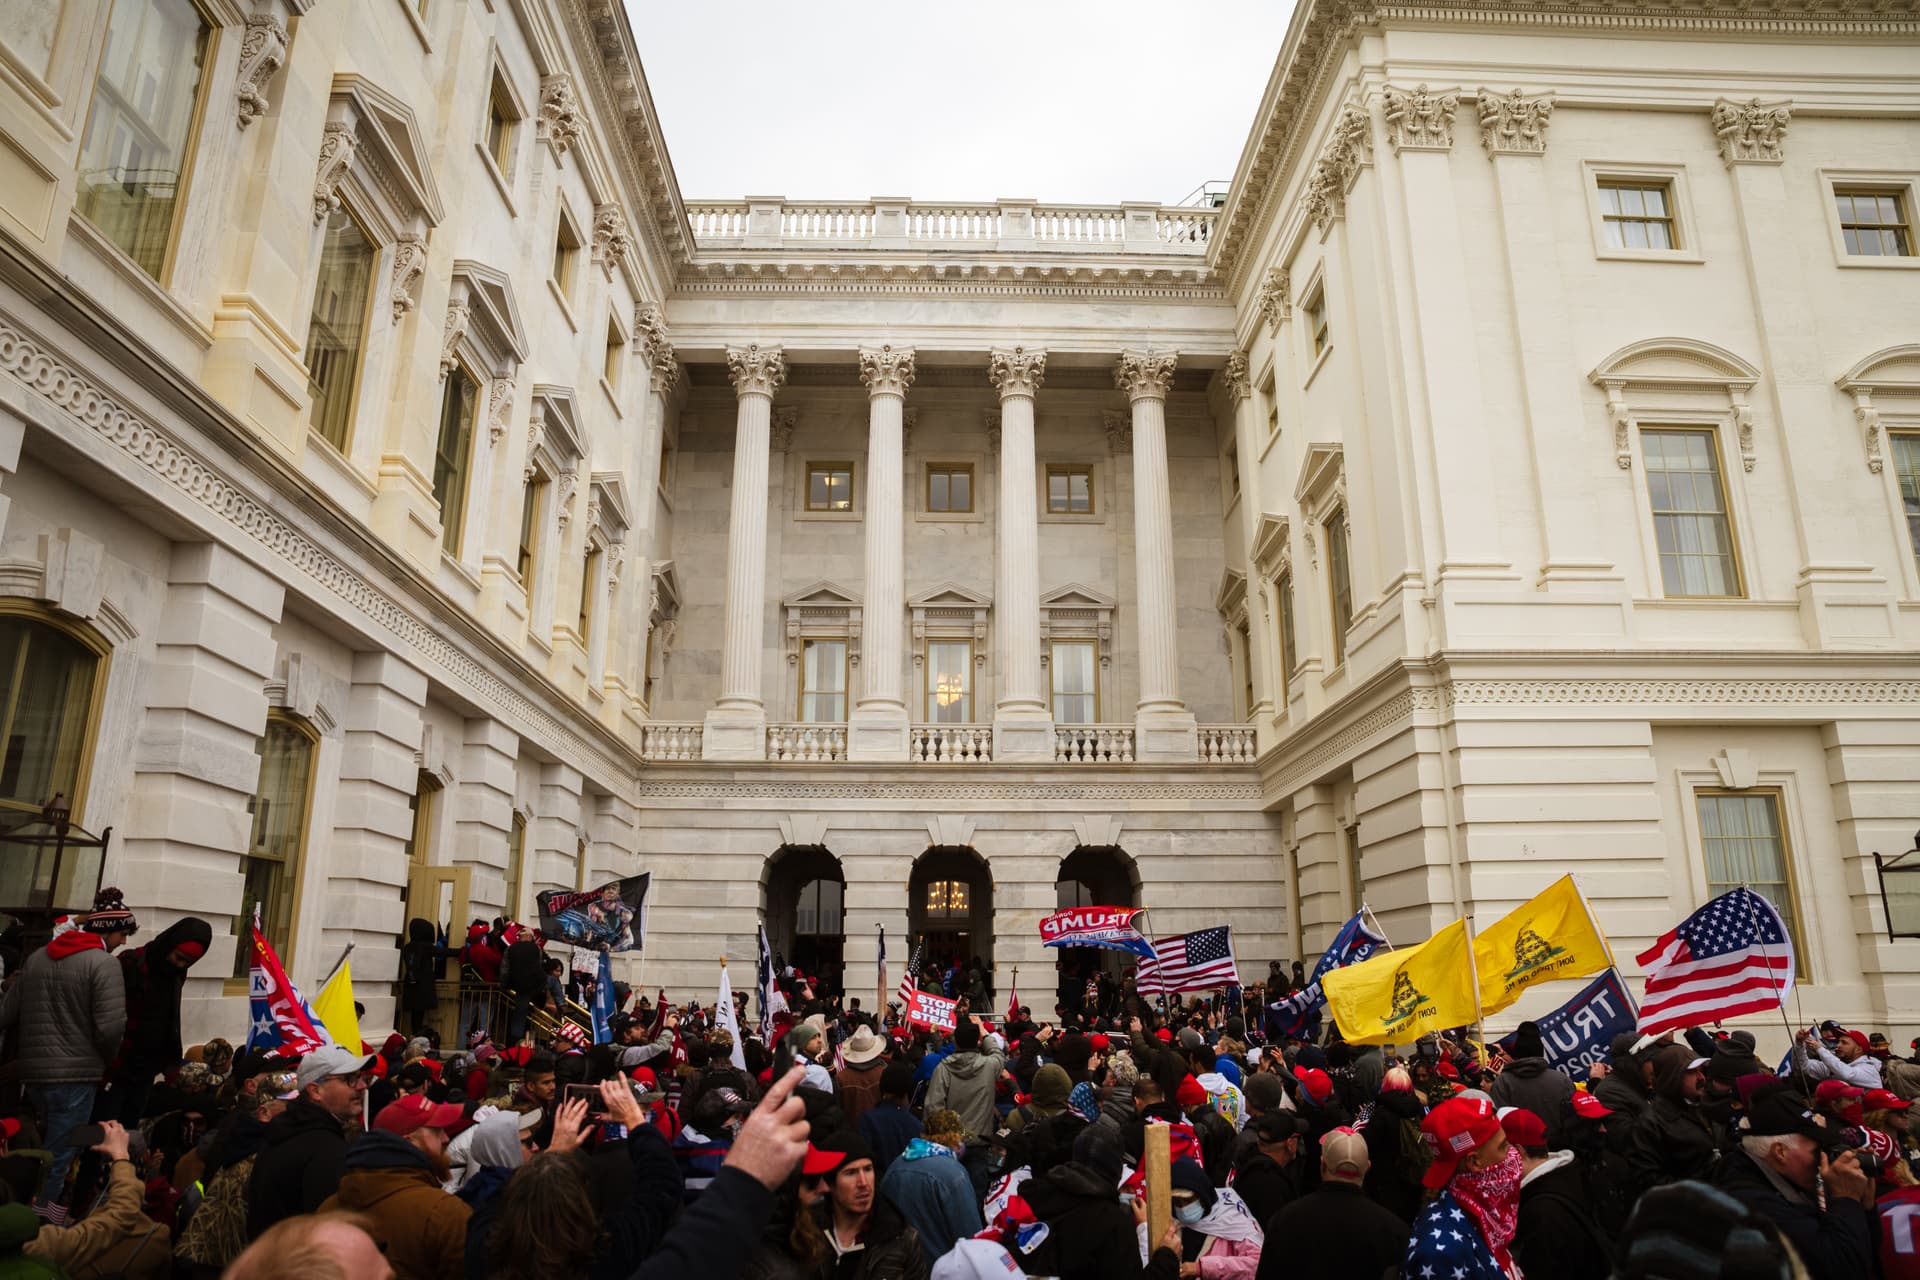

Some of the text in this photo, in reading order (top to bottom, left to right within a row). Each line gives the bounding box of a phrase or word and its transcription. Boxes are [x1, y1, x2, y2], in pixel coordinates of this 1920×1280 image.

[92, 920, 116, 928] NEW
[917, 994, 956, 1010] STOP
[921, 1004, 950, 1018] THE
[911, 1009, 957, 1030] STEAL
